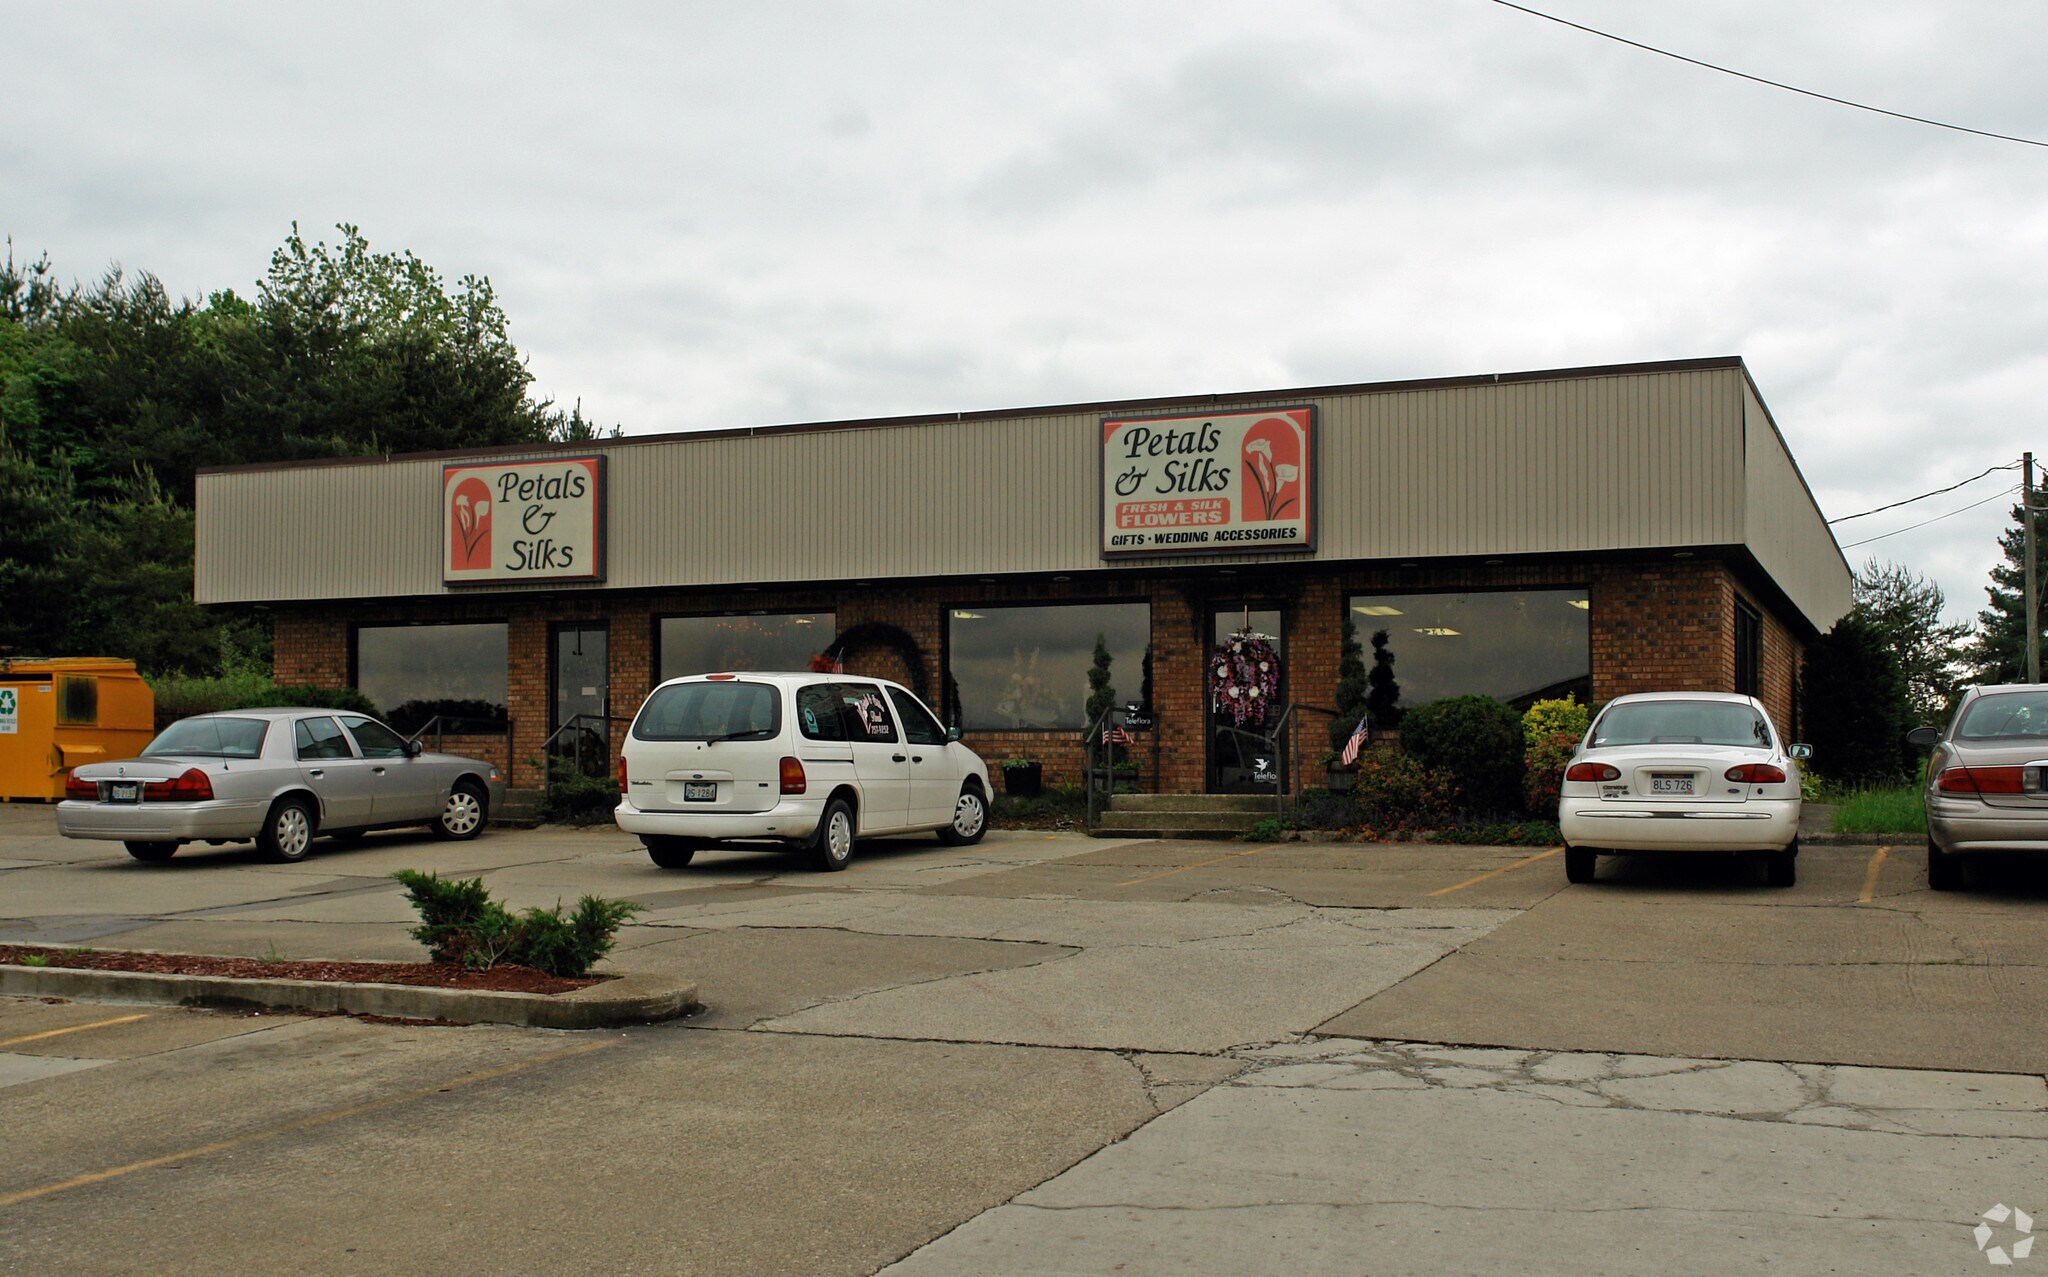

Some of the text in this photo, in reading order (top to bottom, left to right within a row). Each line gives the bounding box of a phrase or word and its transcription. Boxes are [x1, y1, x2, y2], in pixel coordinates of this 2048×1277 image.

[1123, 421, 1221, 459] Petals
[497, 469, 585, 503] Petals
[1115, 457, 1231, 496] & Silks
[1122, 499, 1223, 514] FRESH & SILK
[522, 503, 557, 535] &
[1121, 510, 1222, 527] FLOWERS
[1111, 527, 1297, 546] GIFTS WEDDING ACCESSORIES
[505, 538, 574, 571] Silks
[1125, 717, 1151, 725] Teleflora
[1253, 771, 1277, 780] Teleflo
[1653, 780, 1693, 791] 8LS 726
